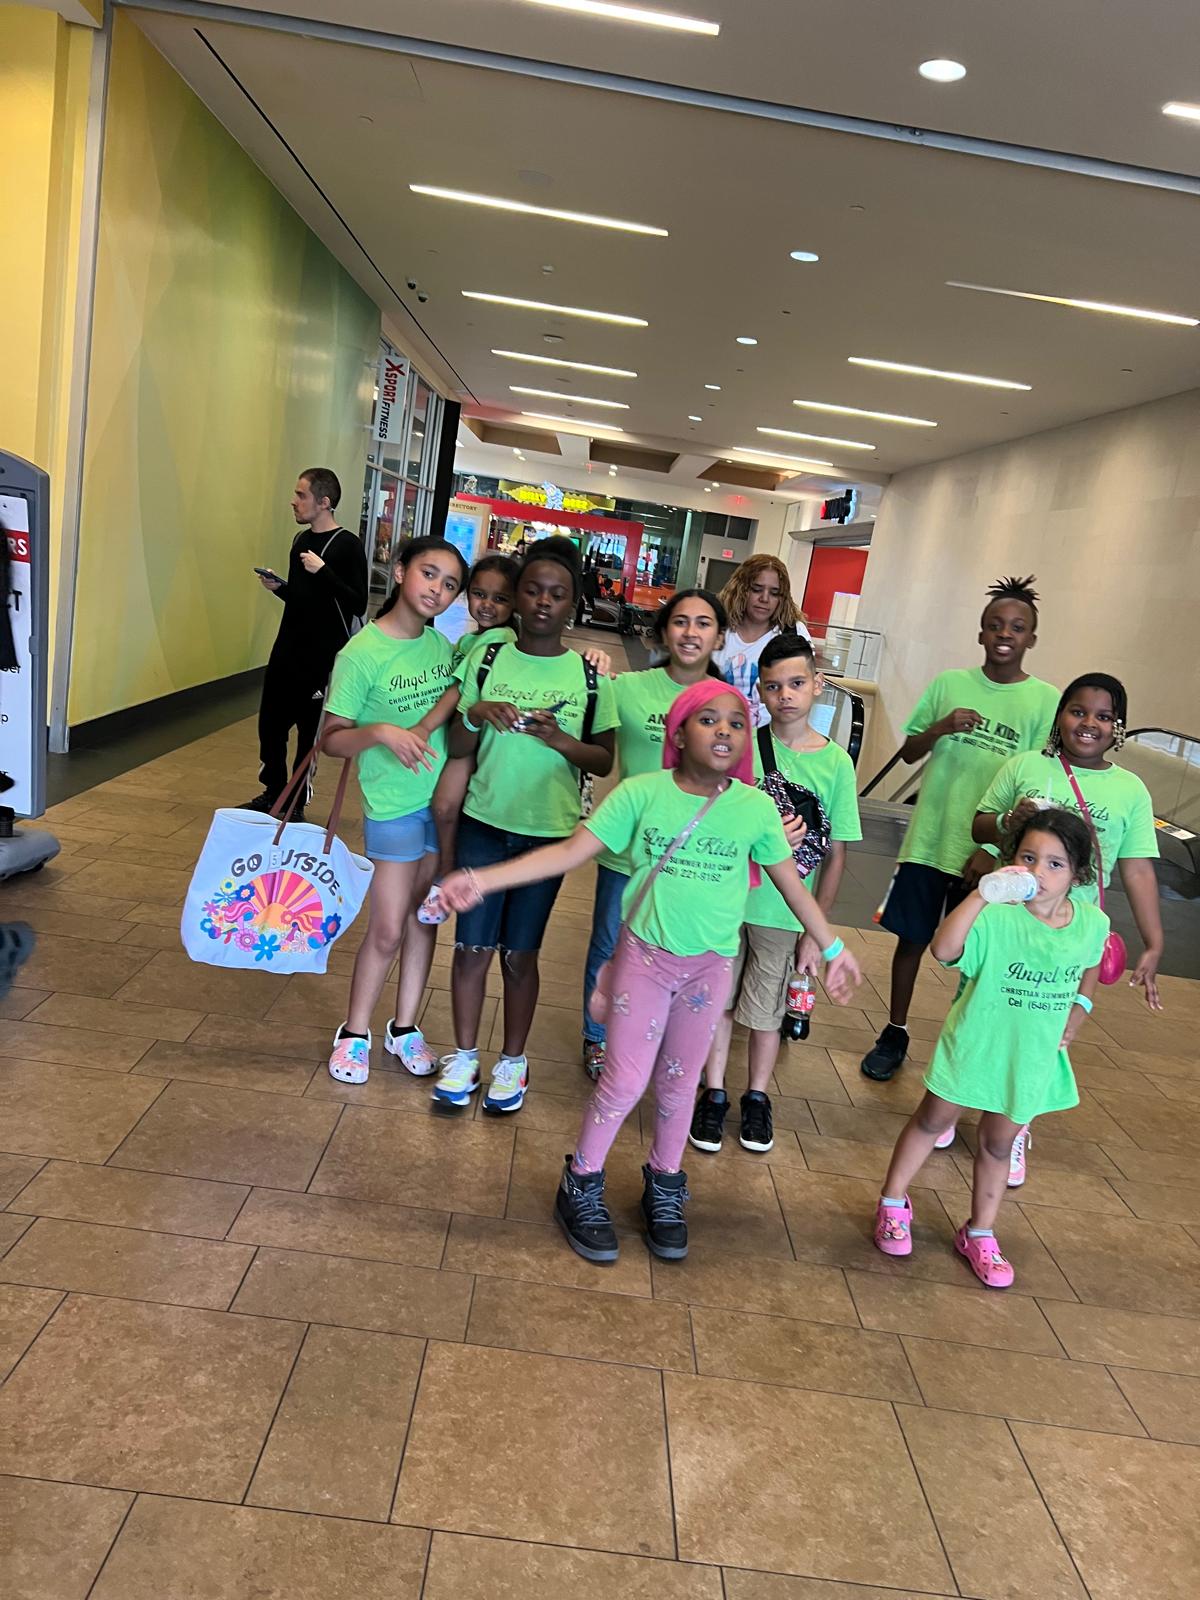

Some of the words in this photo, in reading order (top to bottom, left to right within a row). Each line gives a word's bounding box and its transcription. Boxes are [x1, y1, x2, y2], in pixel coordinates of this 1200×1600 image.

[378, 401, 390, 439] FITNESS
[389, 670, 428, 692] Angel
[388, 691, 420, 705] CHRISTIAN
[420, 685, 443, 698] SUMMER
[490, 684, 538, 703] Angel
[994, 722, 1020, 743] KIDS
[696, 836, 738, 858] Kids
[231, 853, 262, 878] GO
[281, 849, 340, 897] UTSIDE
[1003, 962, 1059, 989] Angel
[1001, 986, 1039, 998] CHRISTIAN
[1041, 991, 1070, 1000] SUMMER
[1008, 997, 1023, 1008] Cel
